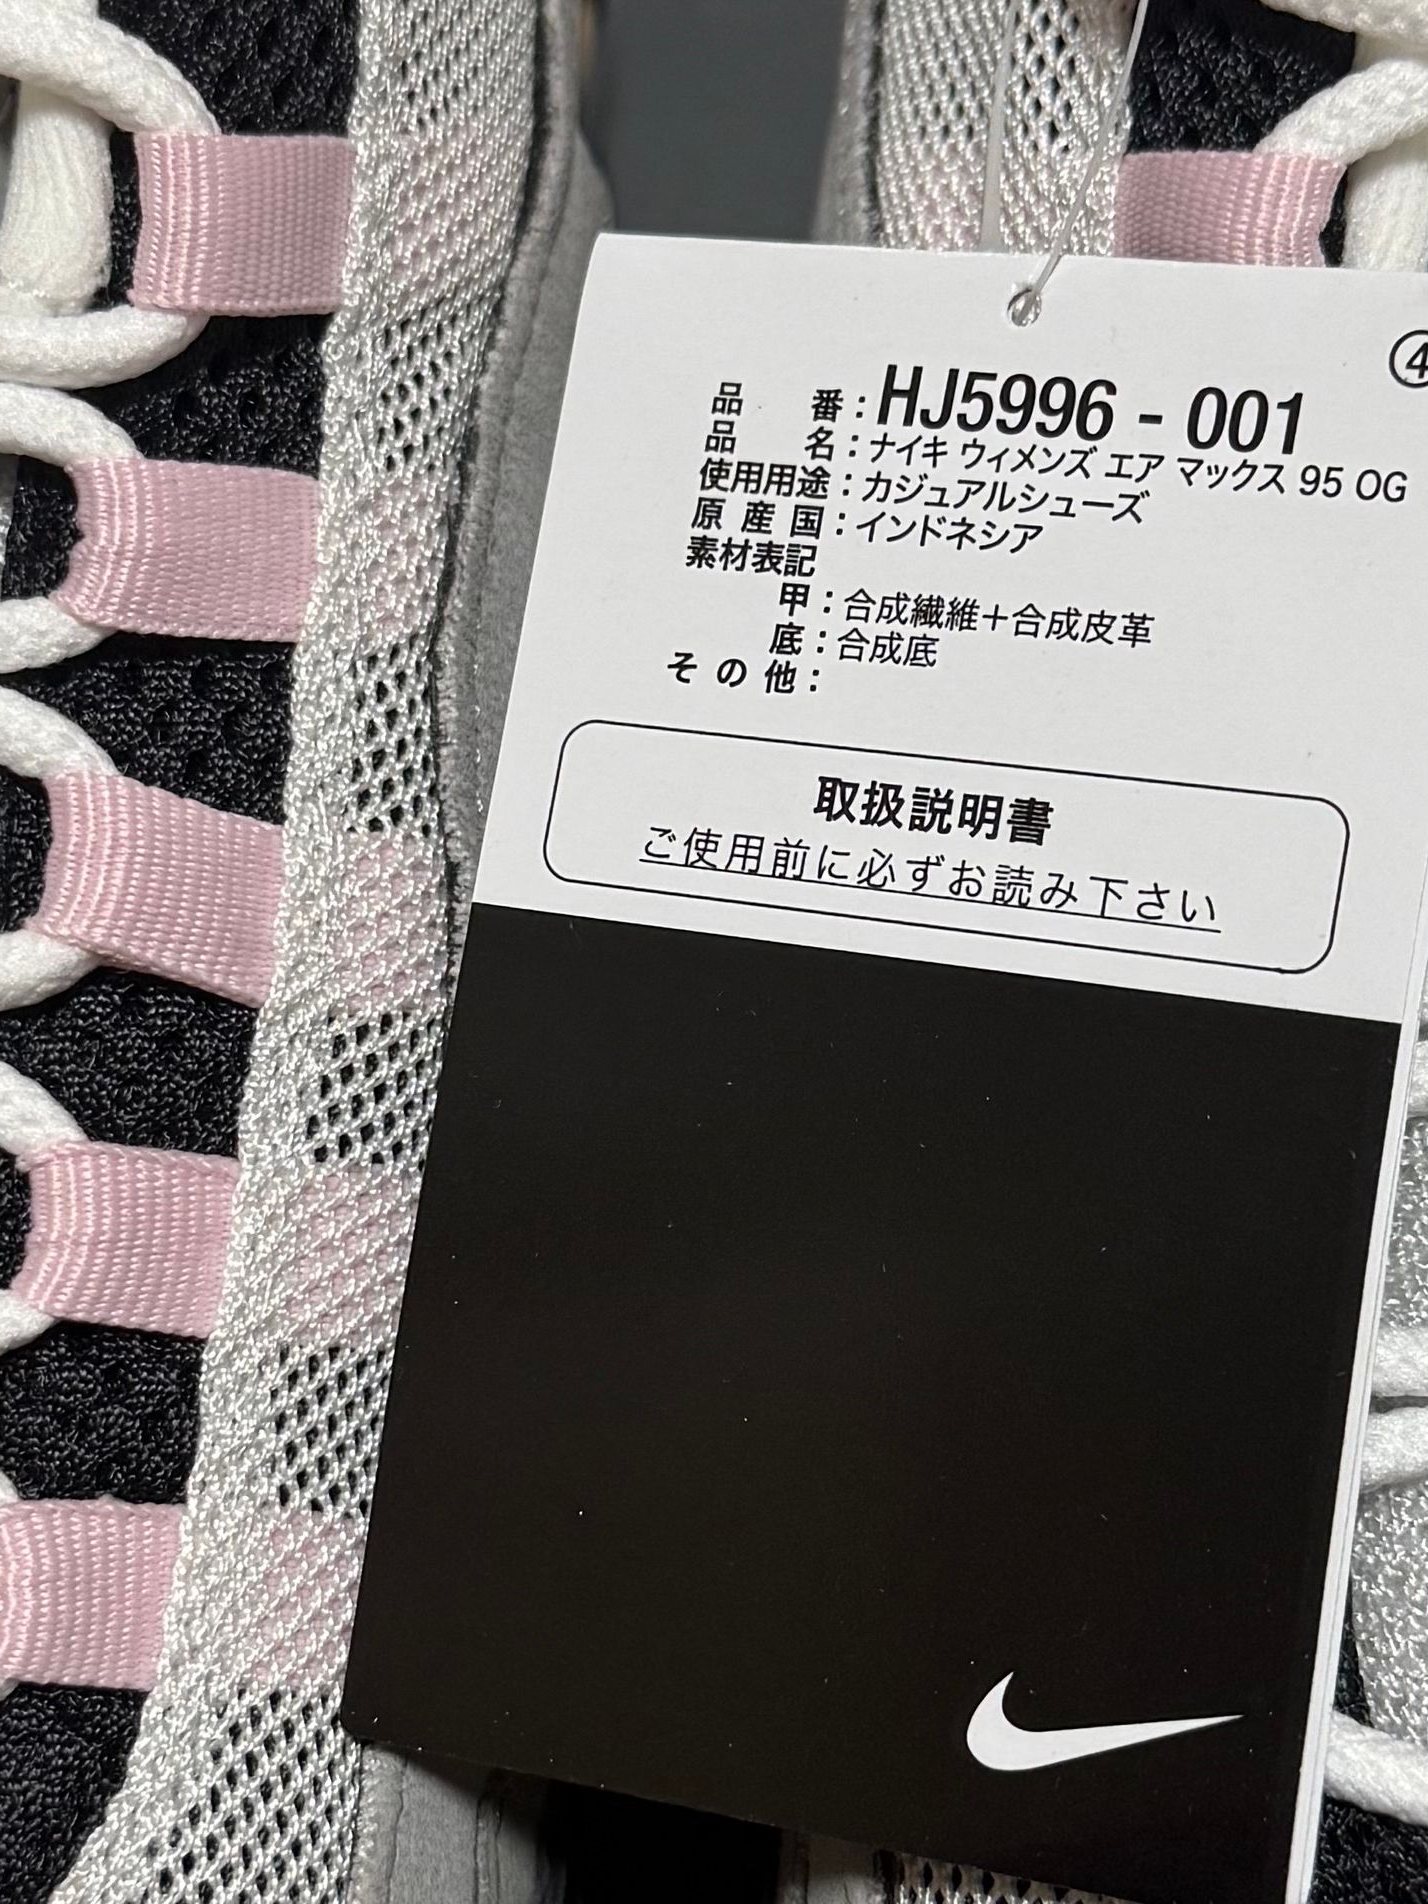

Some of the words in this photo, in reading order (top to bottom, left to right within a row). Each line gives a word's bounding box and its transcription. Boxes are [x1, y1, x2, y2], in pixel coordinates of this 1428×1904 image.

[870, 432, 948, 468] ナイキ
[961, 438, 1097, 479] ウィメンズ
[1105, 454, 1164, 483] エア
[1177, 458, 1284, 494] マックス
[1299, 465, 1343, 498] 95
[1356, 469, 1407, 502] OG
[686, 535, 817, 577] 素材表記
[813, 776, 1054, 846] 取扱説明書
[645, 827, 1214, 922] ご使用前に必ずお読み下さい
